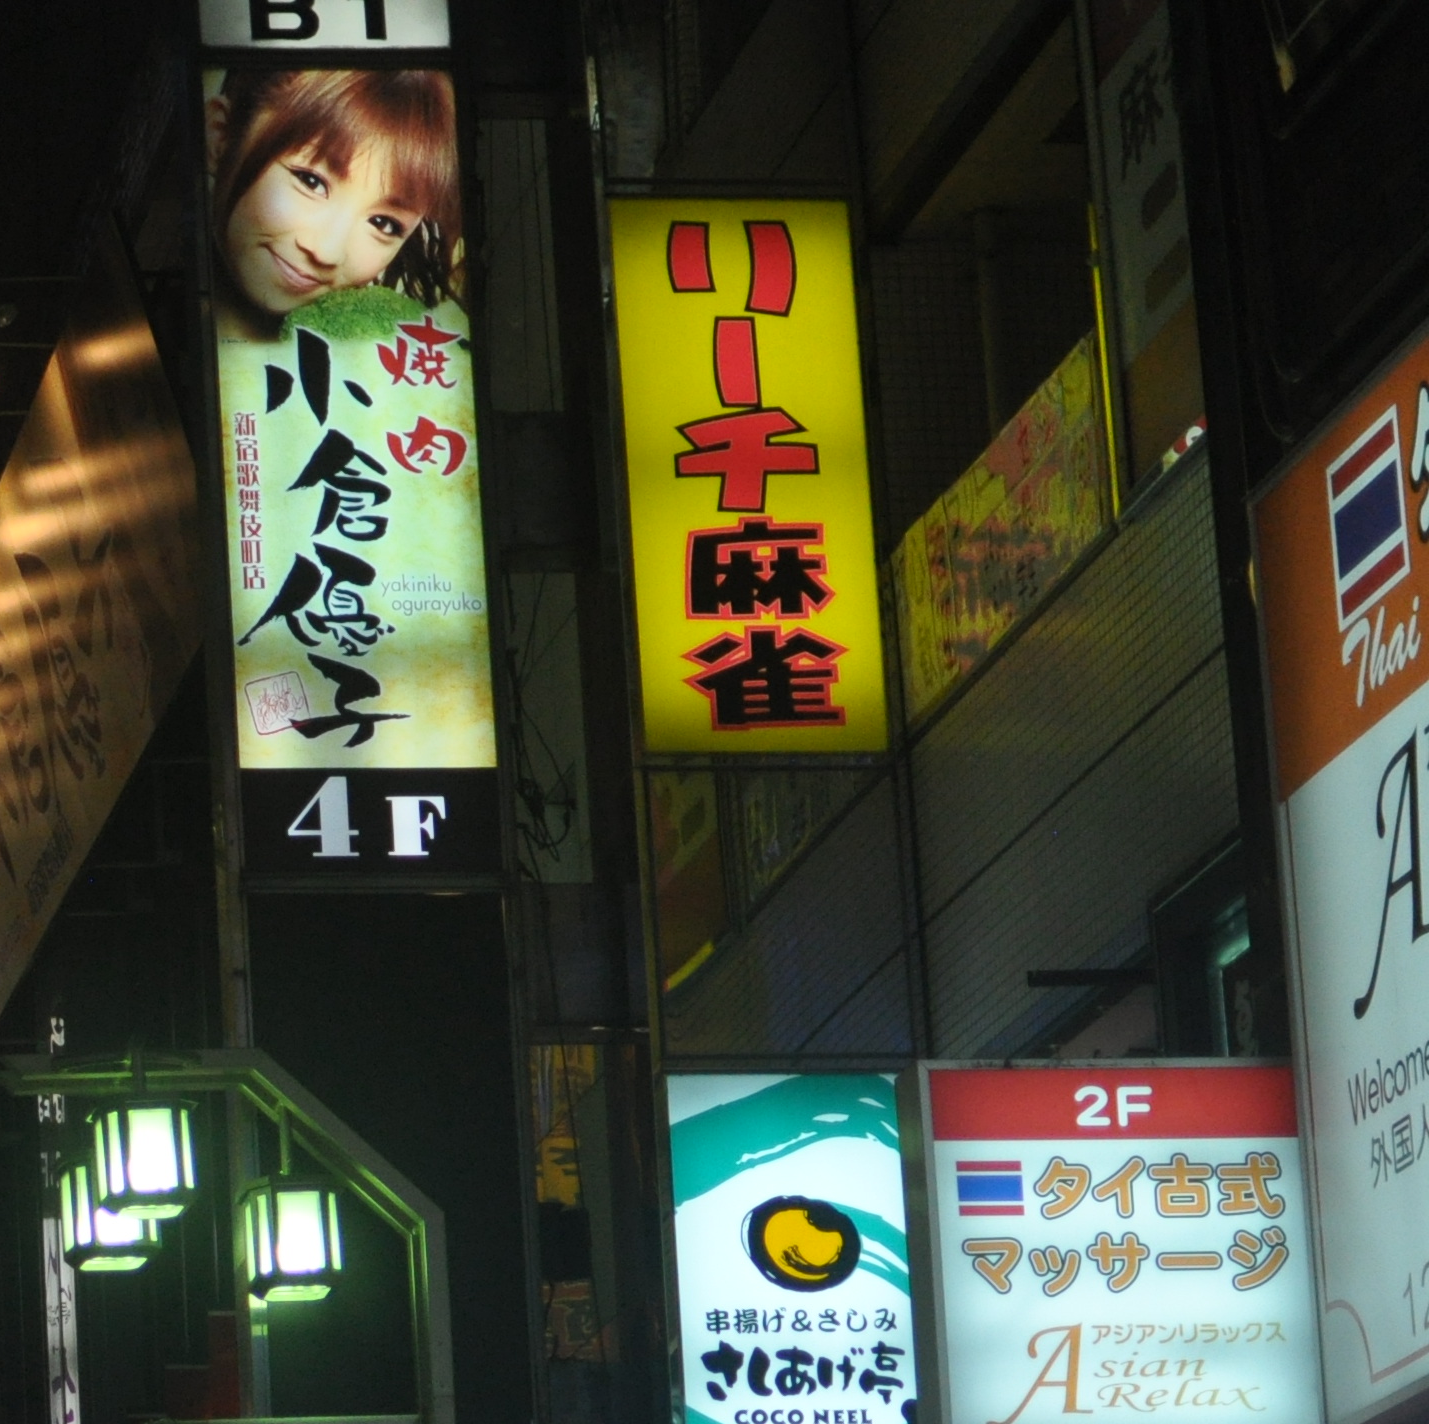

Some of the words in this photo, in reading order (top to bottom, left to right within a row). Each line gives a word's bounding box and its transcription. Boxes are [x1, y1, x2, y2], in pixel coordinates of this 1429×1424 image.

[377, 316, 469, 476] 焼肉
[234, 411, 266, 590] 新宿歌舞伎町店
[668, 220, 849, 731] リーチ麻雀
[237, 328, 411, 748] 小倉優子
[382, 574, 453, 597] yakiniku
[392, 592, 482, 616] ogurayuko
[1342, 596, 1421, 708] Thai
[288, 775, 447, 857] 4F
[1074, 1085, 1153, 1128] 2F
[1033, 1152, 1286, 1220] タイ古式
[962, 1225, 1289, 1297] マッサージ
[705, 1307, 898, 1335] 串揚げ&さしみ
[1092, 1322, 1286, 1345] アジアンリラックス
[700, 1340, 906, 1405] さしあげ亭
[1097, 1378, 1268, 1413] Relax
